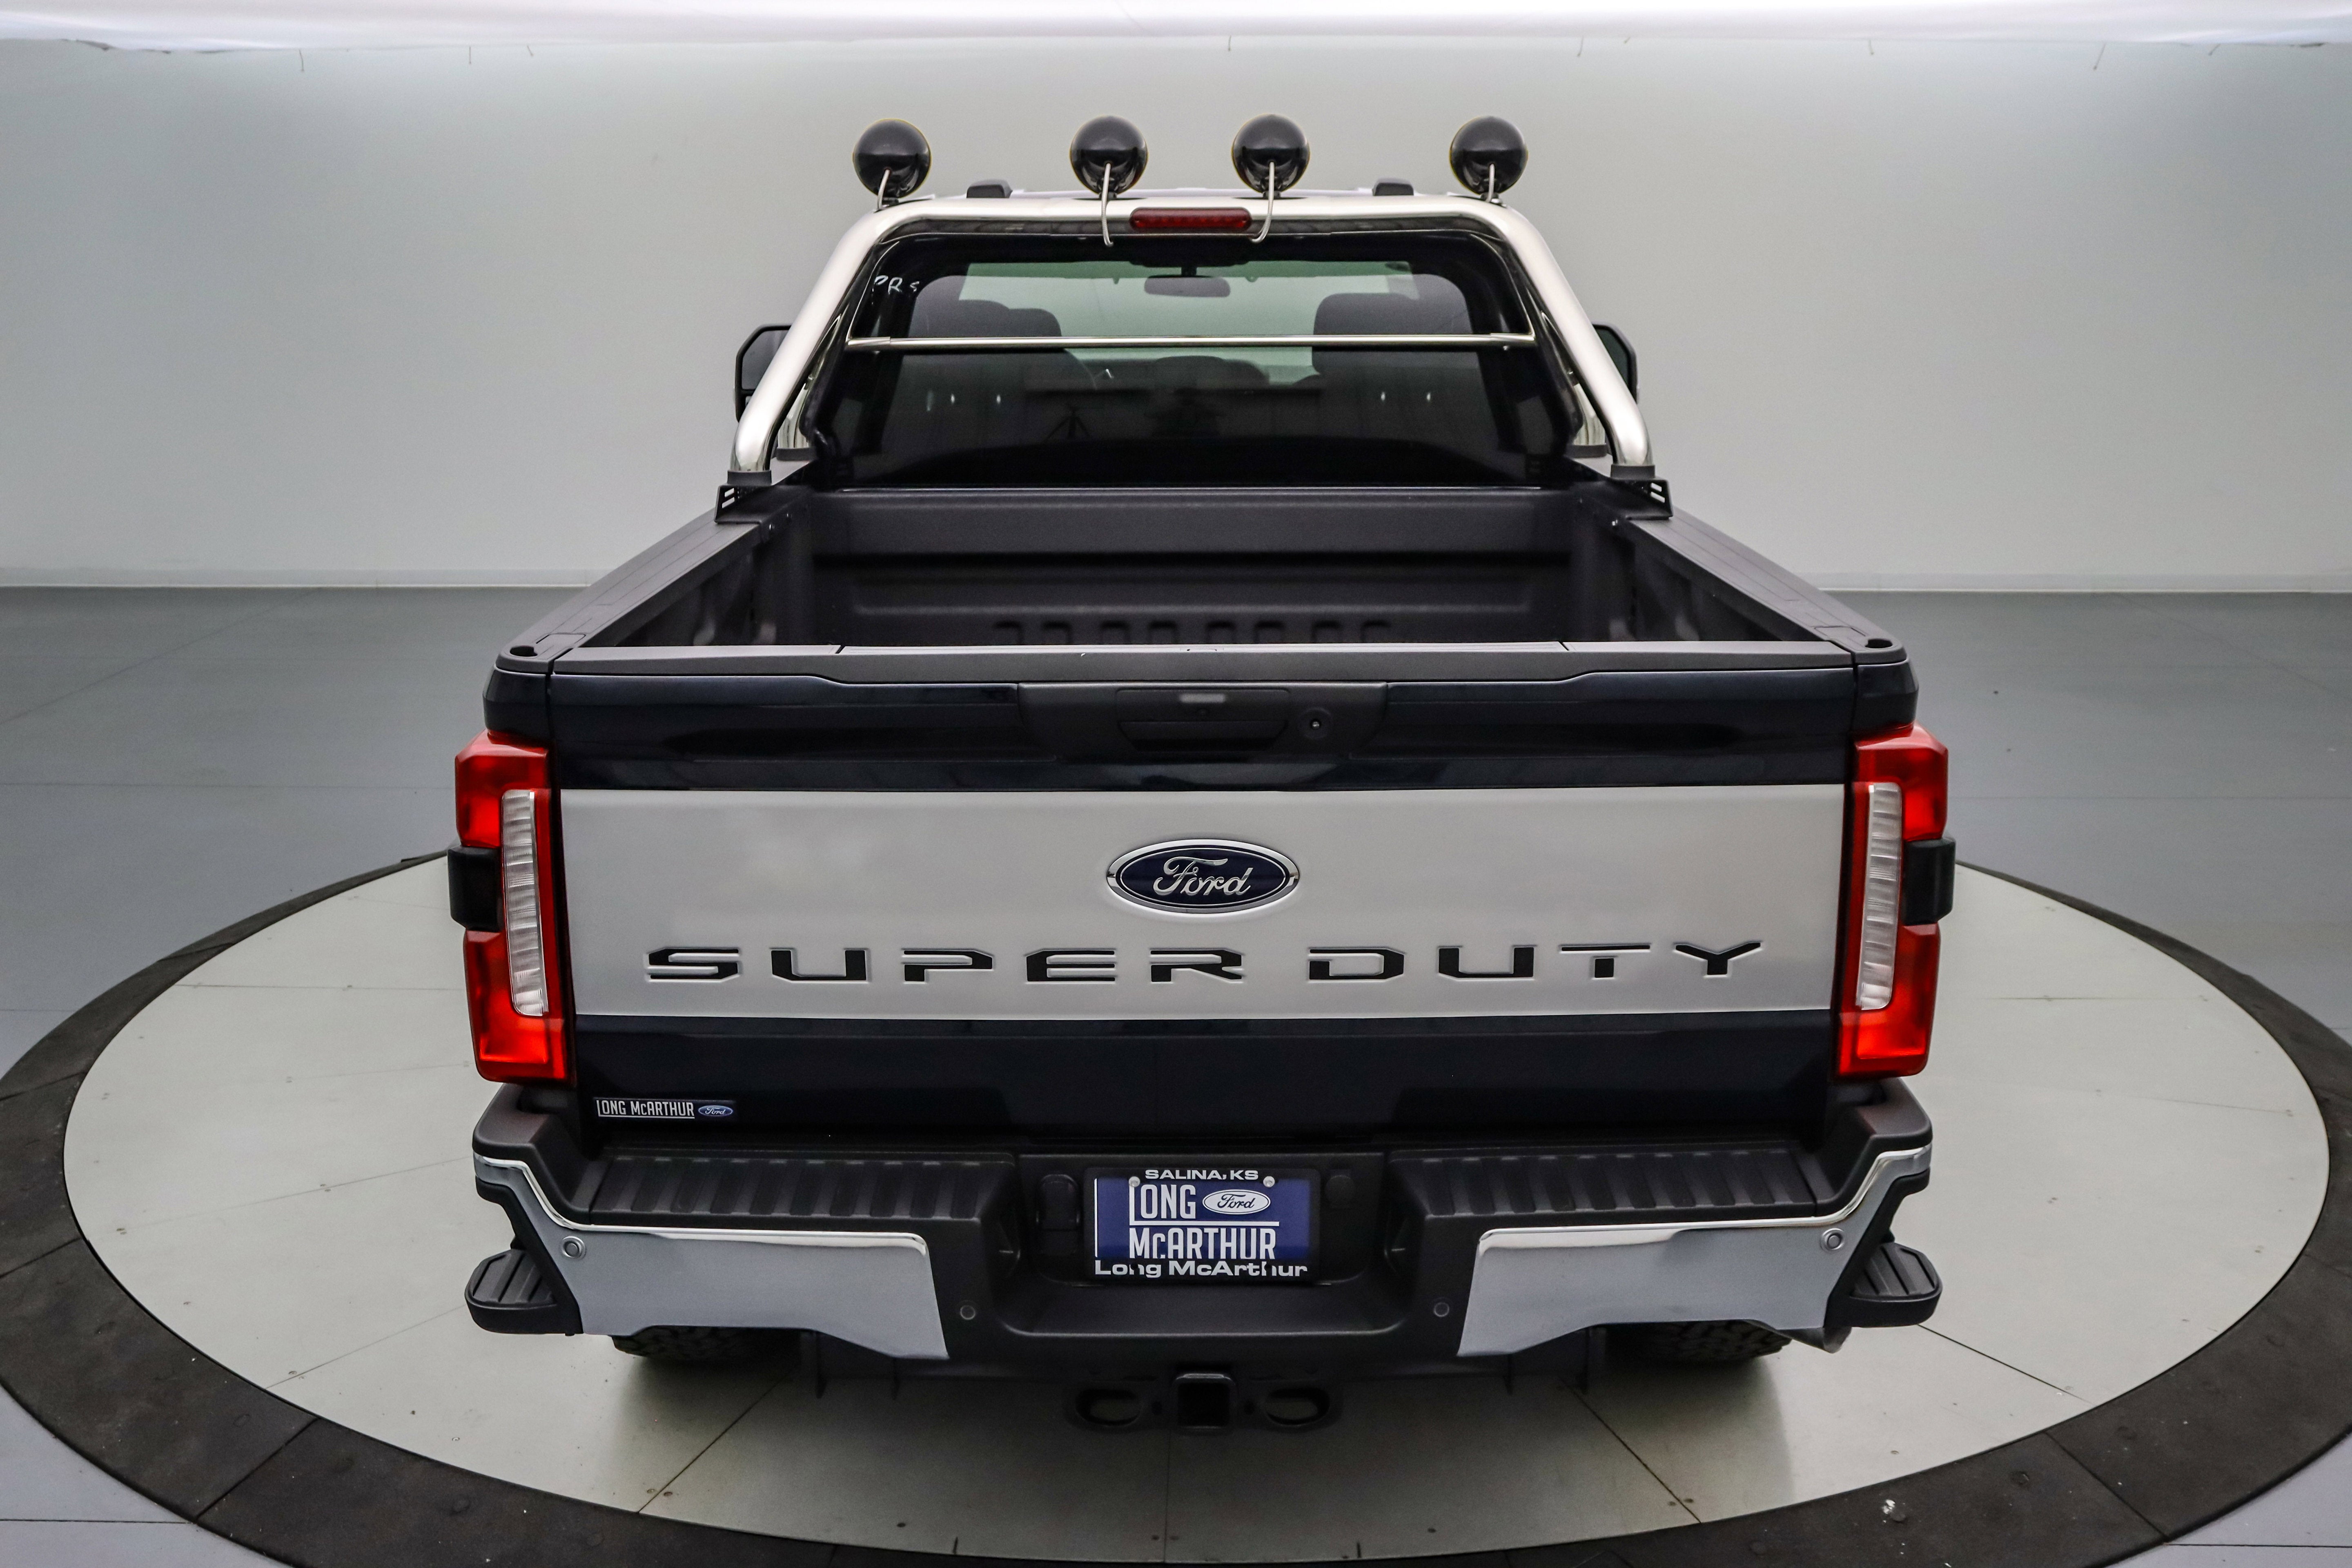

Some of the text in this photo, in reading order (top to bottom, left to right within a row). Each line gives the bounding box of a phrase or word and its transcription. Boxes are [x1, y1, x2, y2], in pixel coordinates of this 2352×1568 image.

[1153, 856, 1254, 896] Ford
[647, 942, 1762, 983] SUPER DUTY
[596, 1100, 726, 1117] LONG McARTHUR Ford
[1145, 1169, 1258, 1180] SALINA, KS
[1129, 1183, 1254, 1225] LONG Ford
[1129, 1227, 1277, 1259] McARTHUR
[1095, 1260, 1308, 1278] Long McArthur
